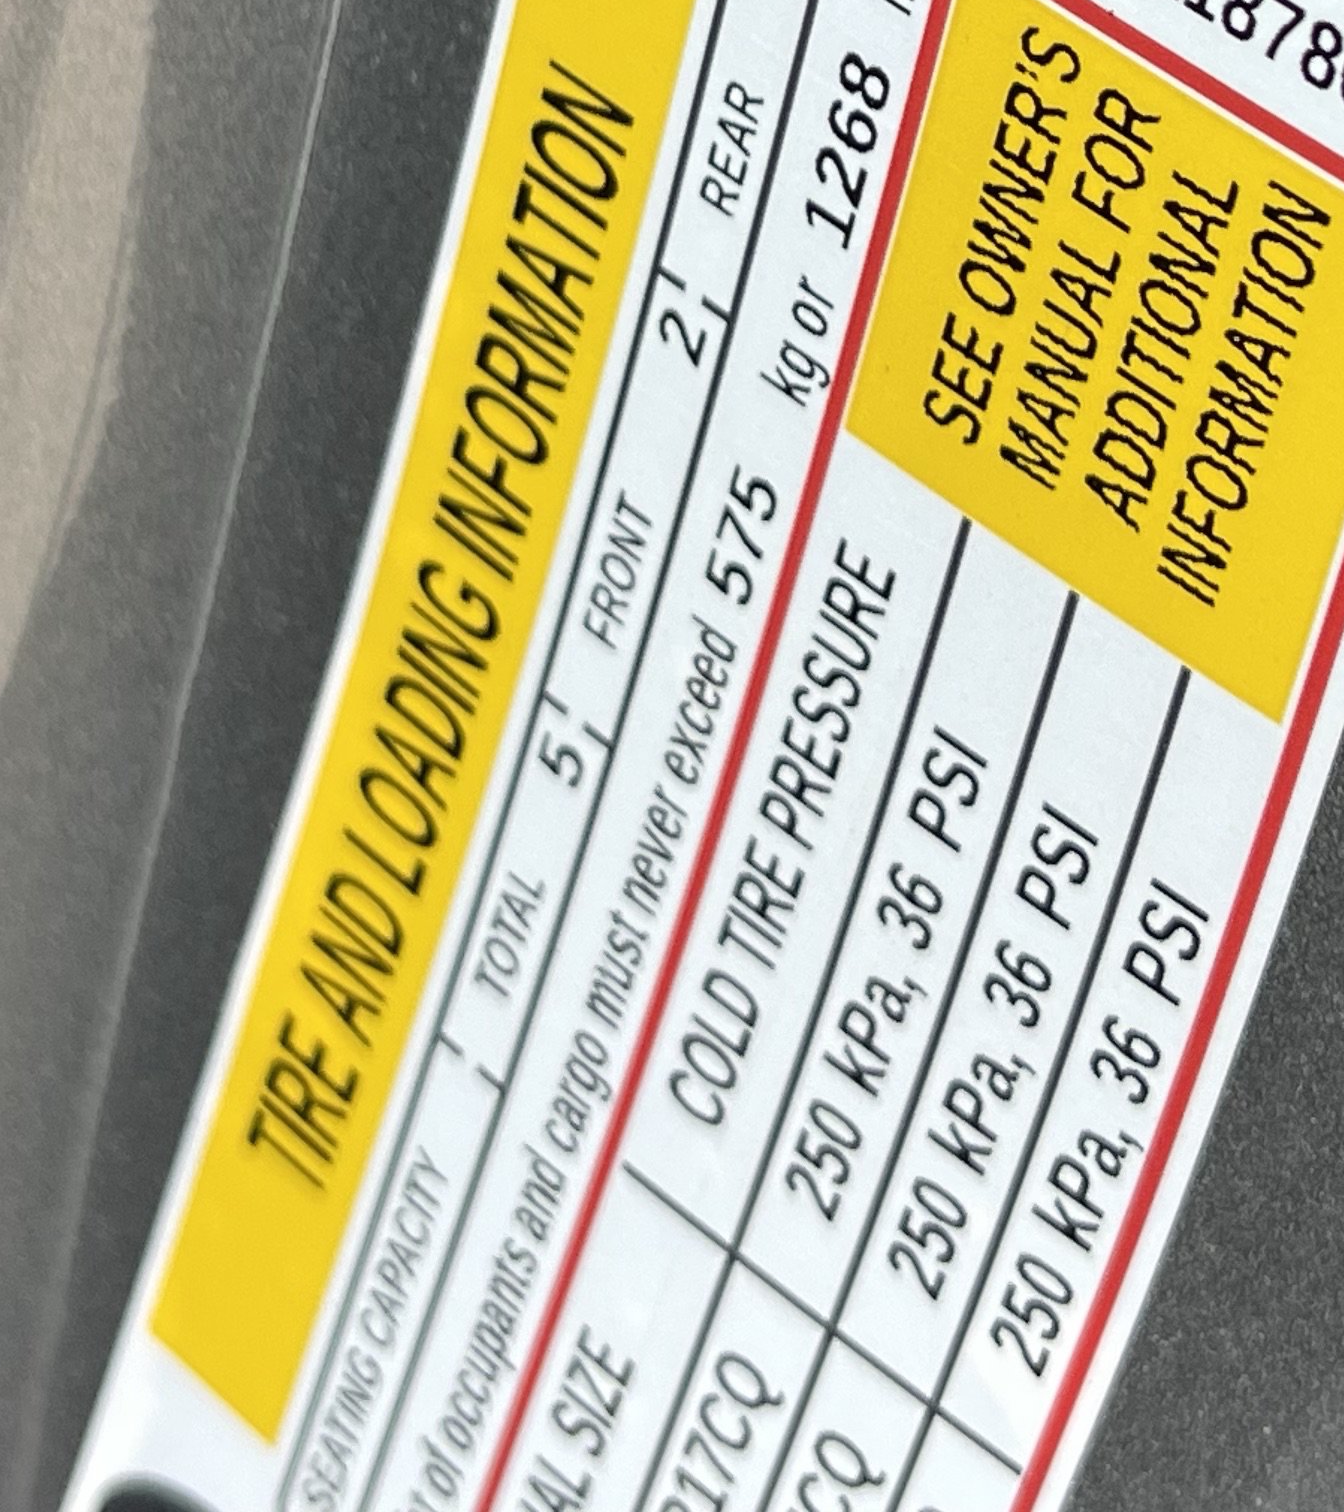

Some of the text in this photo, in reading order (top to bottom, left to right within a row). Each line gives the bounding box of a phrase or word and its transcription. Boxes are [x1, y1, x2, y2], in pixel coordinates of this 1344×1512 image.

[699, 81, 765, 217] REAR
[805, 52, 891, 251] 1268
[791, 274, 835, 338] or
[922, 26, 1082, 446] SEE OWNER'S
[999, 88, 1162, 491] MANUAL FOR
[658, 308, 707, 368] 2
[759, 339, 831, 408] kg
[1084, 169, 1240, 534] ADDITIONAL
[1156, 179, 1332, 608] INFORMATION
[581, 488, 652, 650] FRONT
[704, 464, 778, 606] 575
[246, 59, 634, 1189] TIRE AND LOADING INFORMATION
[663, 614, 738, 785] exceed
[537, 733, 584, 789] 5
[668, 537, 897, 1127] COLD TIRE PRESSURE
[473, 871, 546, 998] TOTAL
[622, 787, 687, 916] never
[584, 910, 649, 1031] must
[784, 725, 988, 1223] 250 kPa, 36 PSI
[887, 802, 1099, 1302] 250 kPa, 36 PSI
[544, 1030, 613, 1155] cargo
[989, 877, 1210, 1379] 250 kPa, 36 PSI
[359, 1145, 448, 1350] CAPACITY
[514, 1143, 566, 1244] and
[439, 1236, 538, 1454] occupants
[520, 1324, 635, 1512] AL SIZE
[421, 1435, 465, 1502] of
